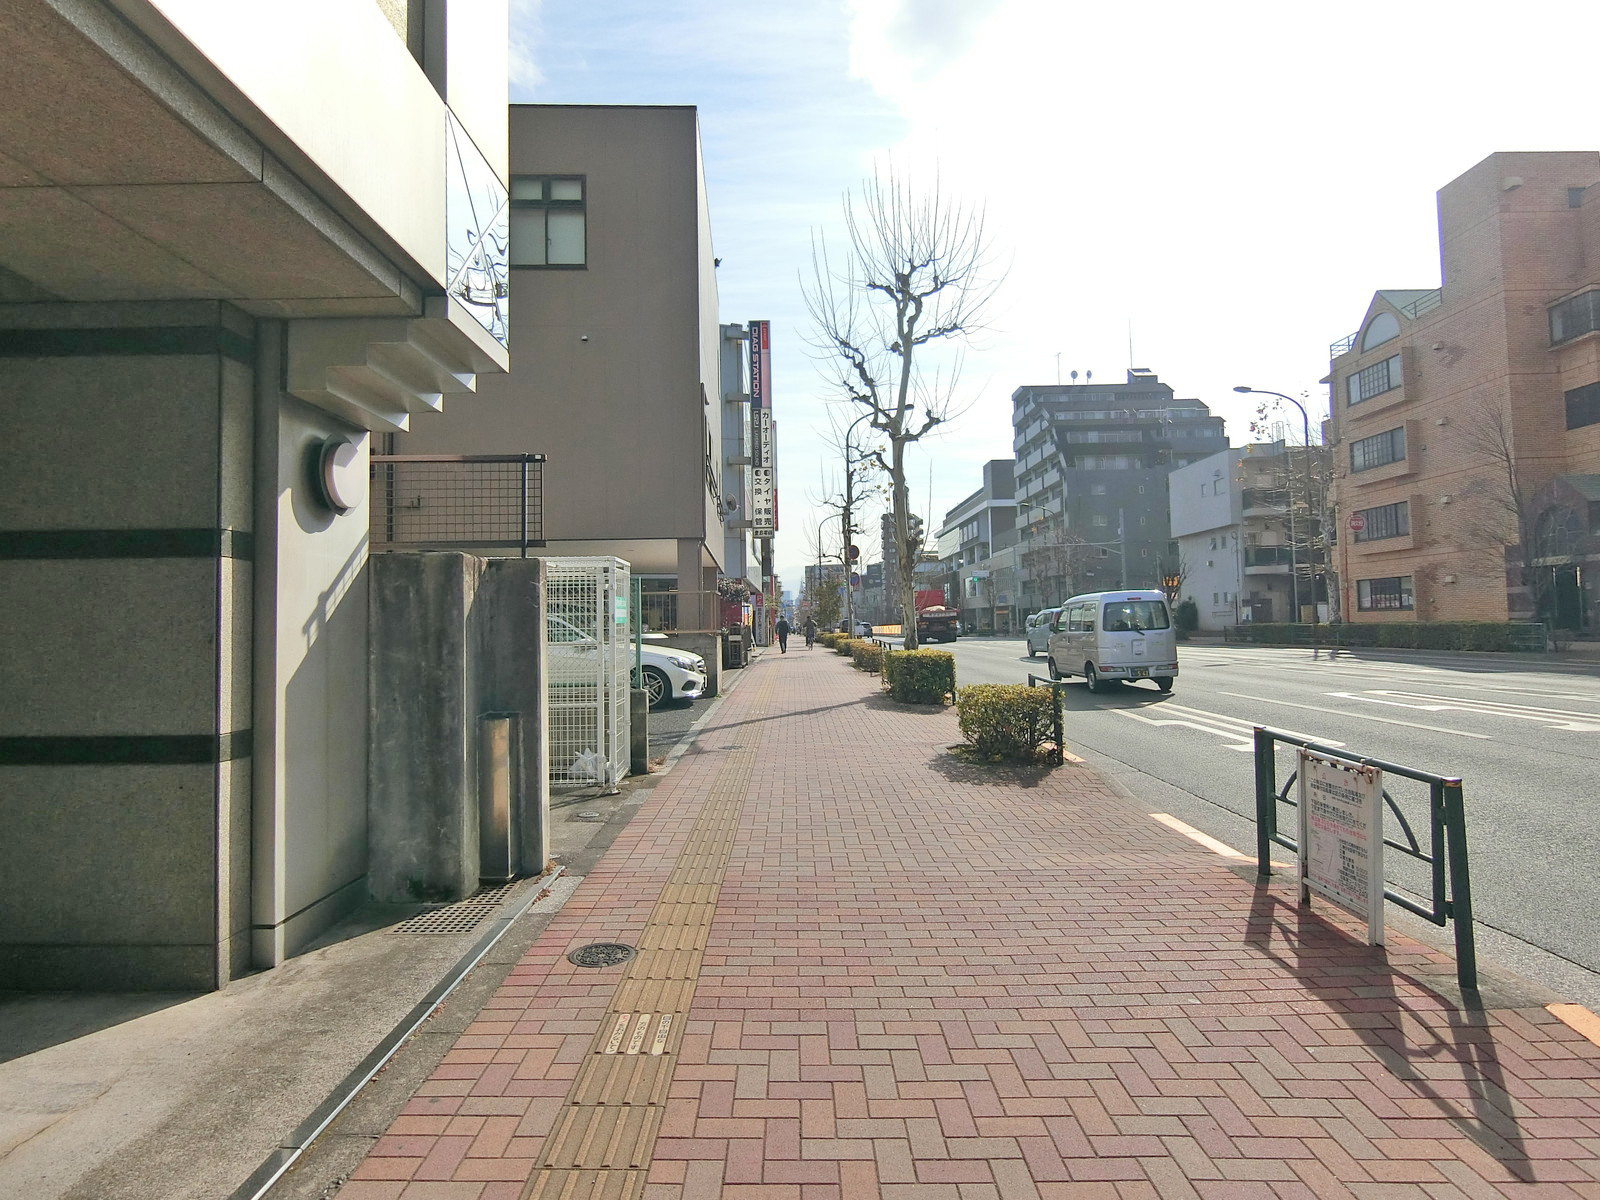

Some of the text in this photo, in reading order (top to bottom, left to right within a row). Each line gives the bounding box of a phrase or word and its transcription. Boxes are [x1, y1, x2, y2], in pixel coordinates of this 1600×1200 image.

[754, 478, 762, 526] 交換・保管
[764, 478, 772, 526] タイヤ販売
[657, 1016, 672, 1044] 目の不自由な
